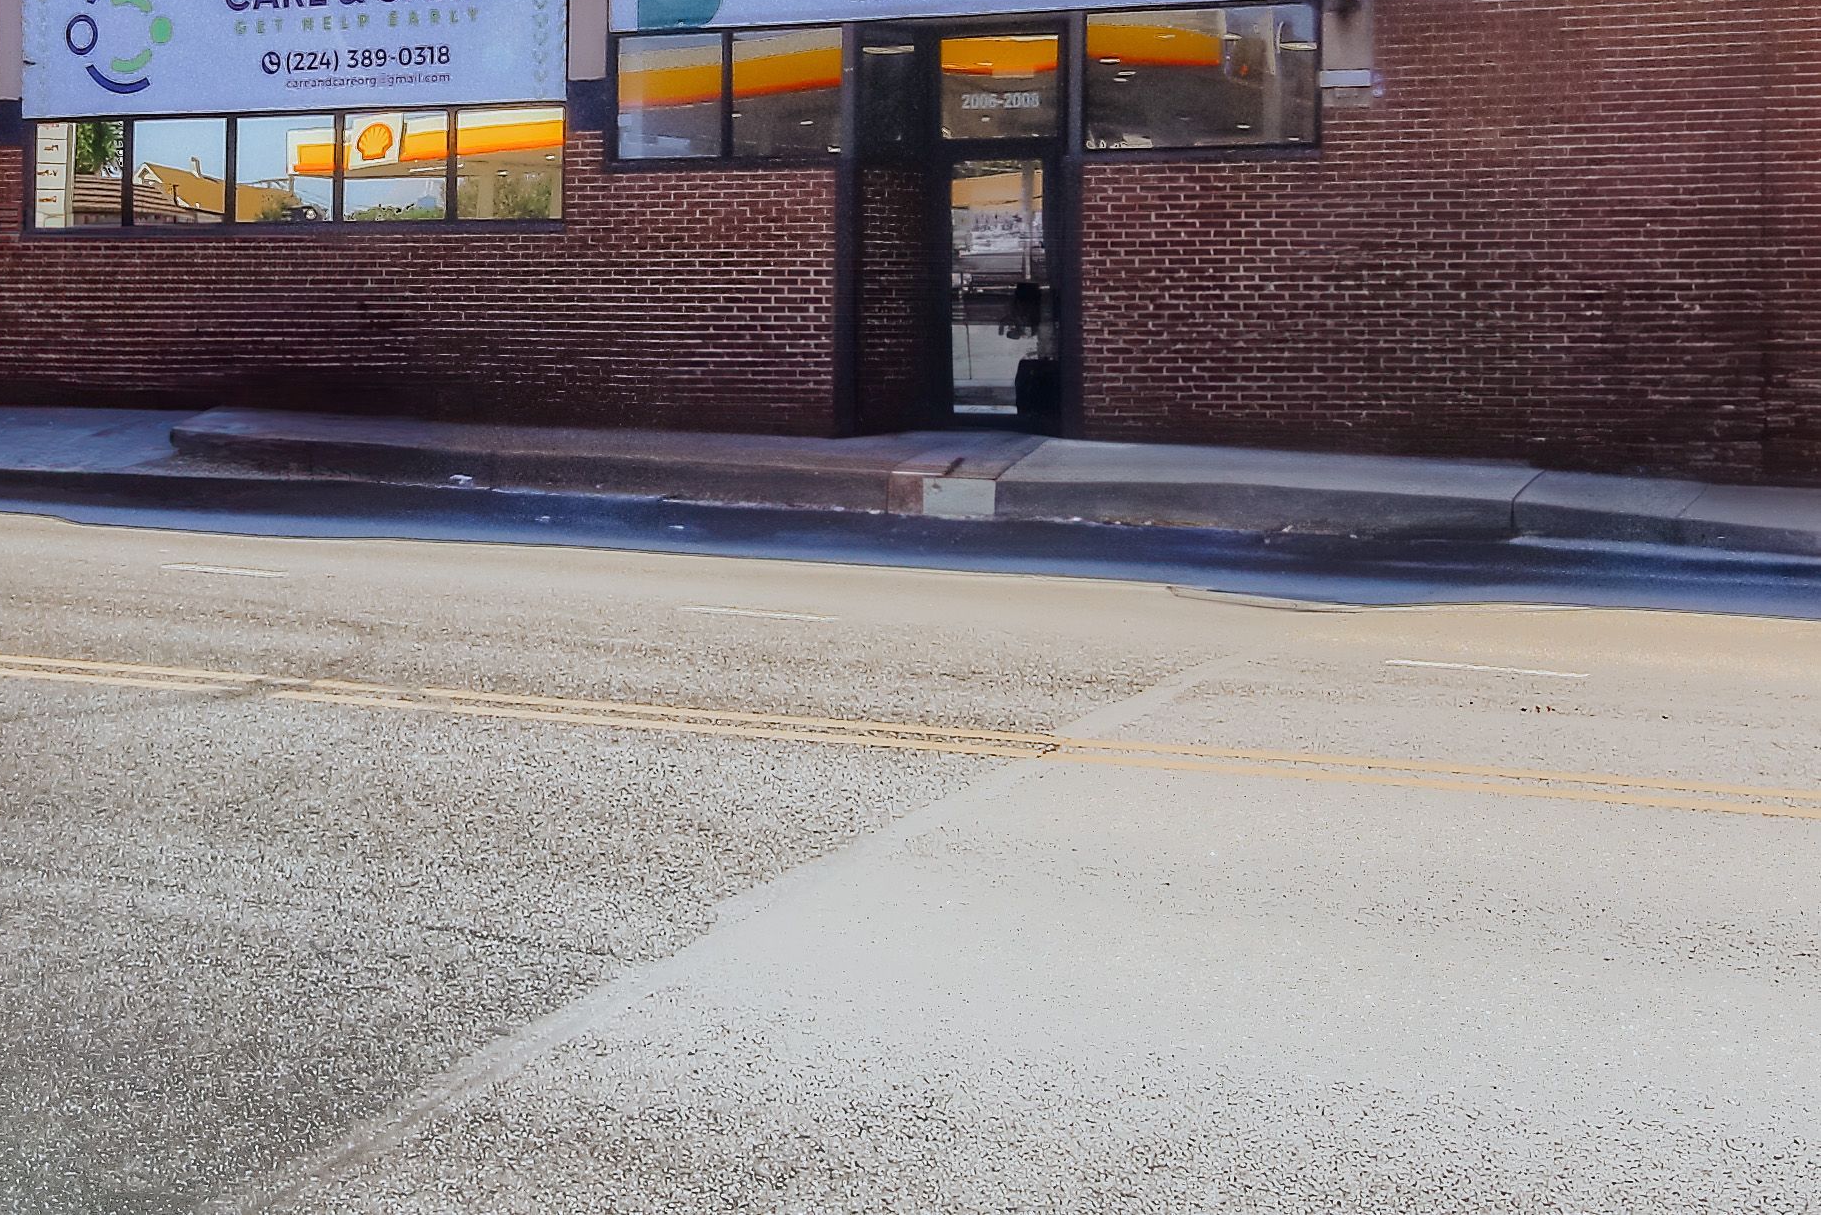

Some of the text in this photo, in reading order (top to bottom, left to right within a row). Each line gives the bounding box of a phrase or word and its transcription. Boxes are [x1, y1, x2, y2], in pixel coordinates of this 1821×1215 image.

[234, 7, 479, 35] GET HELP EARLY
[286, 45, 451, 73] (224) 389-0318
